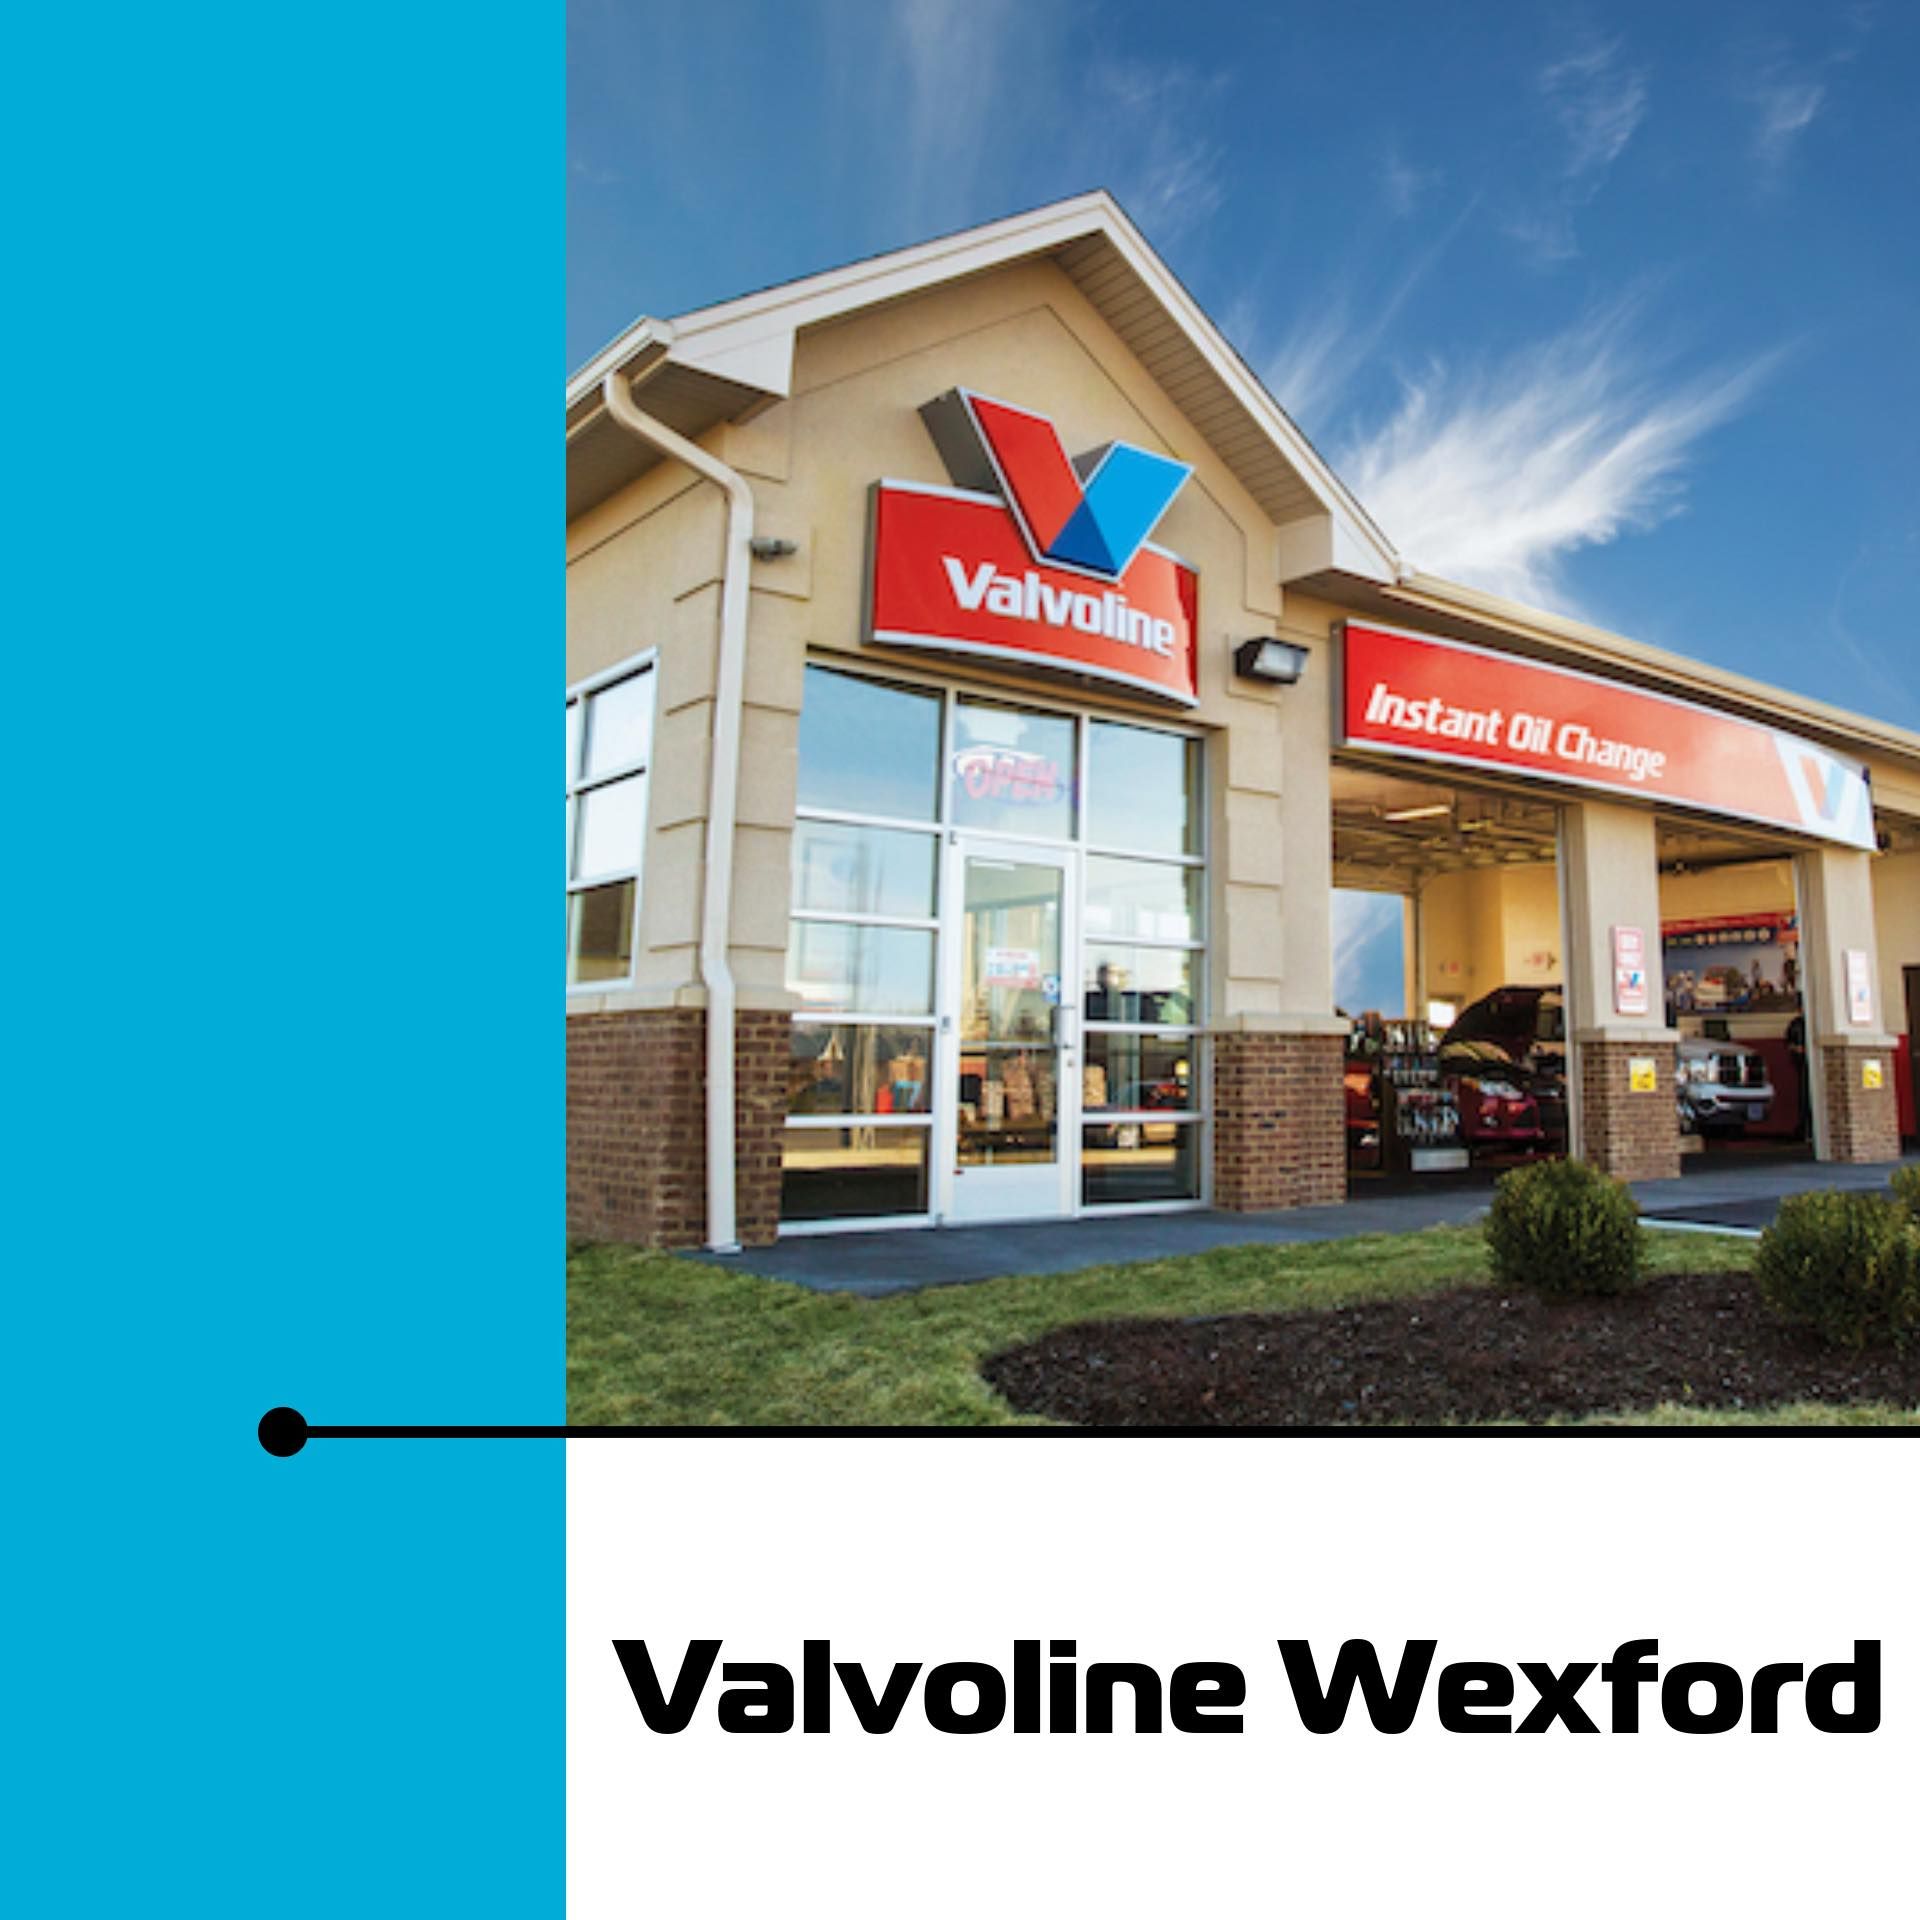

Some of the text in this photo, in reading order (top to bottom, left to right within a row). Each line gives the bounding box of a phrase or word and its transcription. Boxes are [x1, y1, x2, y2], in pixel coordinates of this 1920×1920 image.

[943, 556, 1176, 656] Valvoline
[1365, 683, 1667, 781] Instant Oil Change
